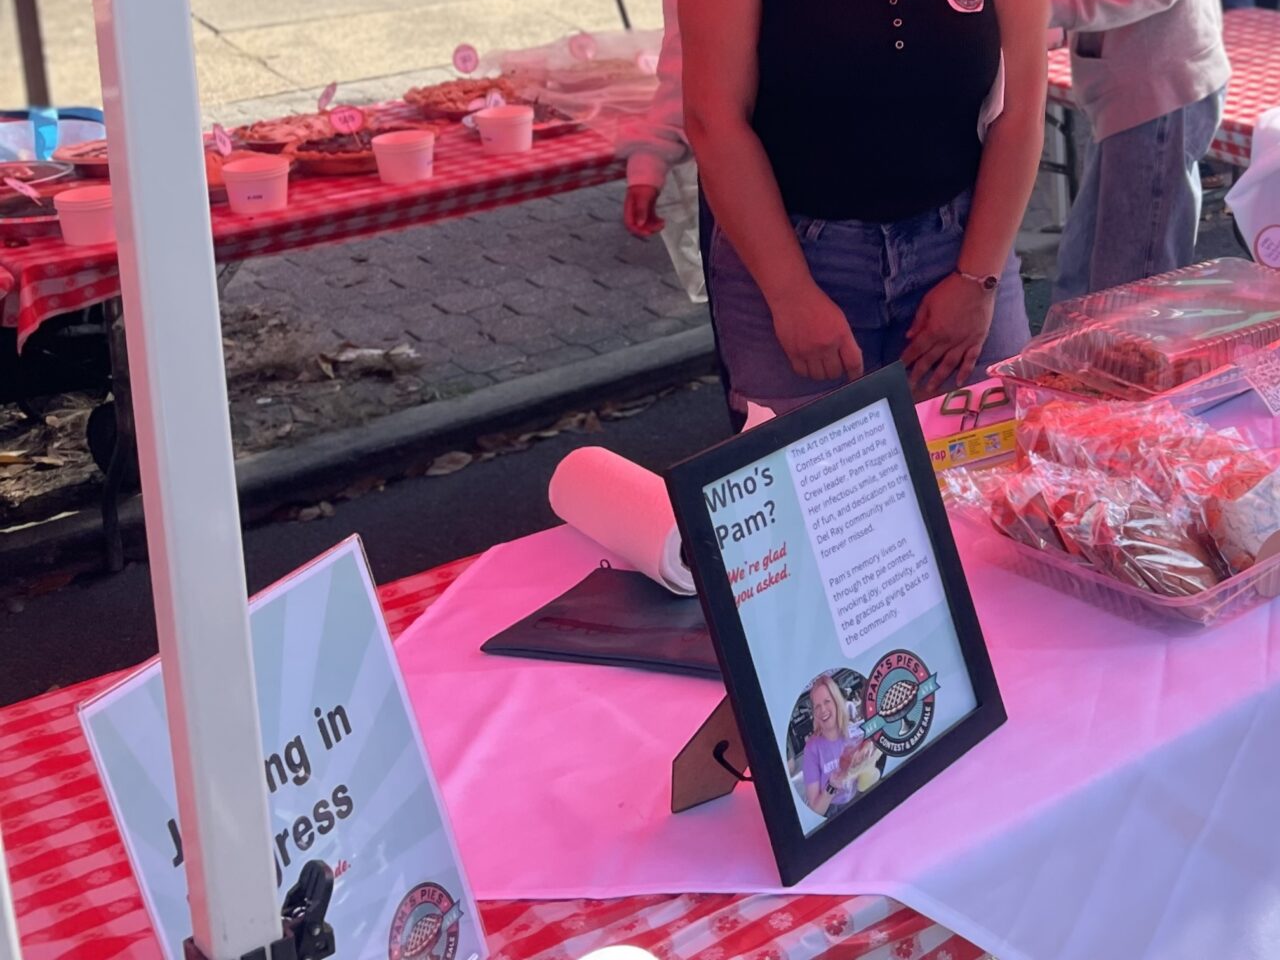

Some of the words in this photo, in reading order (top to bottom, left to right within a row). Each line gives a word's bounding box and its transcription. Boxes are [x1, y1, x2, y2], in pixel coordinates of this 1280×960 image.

[791, 448, 805, 458] The
[807, 441, 818, 451] Art
[820, 436, 828, 446] on
[829, 429, 841, 439] the
[843, 418, 868, 433] Avenue
[869, 410, 880, 421] Pie
[796, 453, 824, 473] Contest
[826, 450, 832, 459] is
[833, 439, 856, 454] named
[857, 433, 864, 441] in
[865, 423, 885, 438] honor
[929, 449, 946, 464] rap
[801, 476, 808, 487] of
[809, 471, 821, 482] our
[823, 462, 838, 476] dear
[840, 451, 861, 466] friend
[862, 443, 875, 453] and
[876, 438, 887, 449] Pie
[804, 487, 823, 501] Crew
[849, 466, 865, 477] Pam
[704, 467, 774, 513] Who's
[809, 504, 821, 516] Her
[823, 485, 858, 507] infectious
[879, 463, 898, 478] sense
[812, 519, 820, 530] of
[837, 504, 850, 517] and
[852, 486, 887, 509] dedication
[888, 479, 895, 488] to
[896, 473, 908, 483] the
[715, 500, 776, 550] Pam?
[816, 533, 830, 544] Del
[830, 525, 844, 538] Ray
[845, 503, 883, 529] community
[885, 495, 896, 506] will
[897, 490, 905, 500] be
[728, 560, 760, 585] We're
[762, 542, 787, 571] glad
[821, 539, 846, 559] forever
[828, 570, 851, 587] Pam's
[851, 553, 880, 575] memory
[881, 544, 896, 557] lives
[897, 537, 907, 548] on
[734, 587, 755, 609] you
[756, 563, 791, 594] asked.
[833, 579, 862, 602] through
[862, 573, 874, 584] the
[875, 565, 886, 579] pie
[838, 593, 871, 617] invoking
[915, 556, 928, 569] and
[841, 619, 854, 631] the
[856, 600, 885, 625] gracious
[886, 587, 905, 606] giving
[905, 578, 921, 591] back
[922, 572, 929, 581] to
[845, 634, 858, 645] the
[868, 658, 892, 702] PAM'S
[897, 655, 920, 673] PIES
[314, 705, 352, 750] in
[880, 736, 904, 752] CONTEST
[910, 728, 924, 745] BAKE
[922, 705, 931, 727] SALE
[421, 889, 444, 906] PIES
